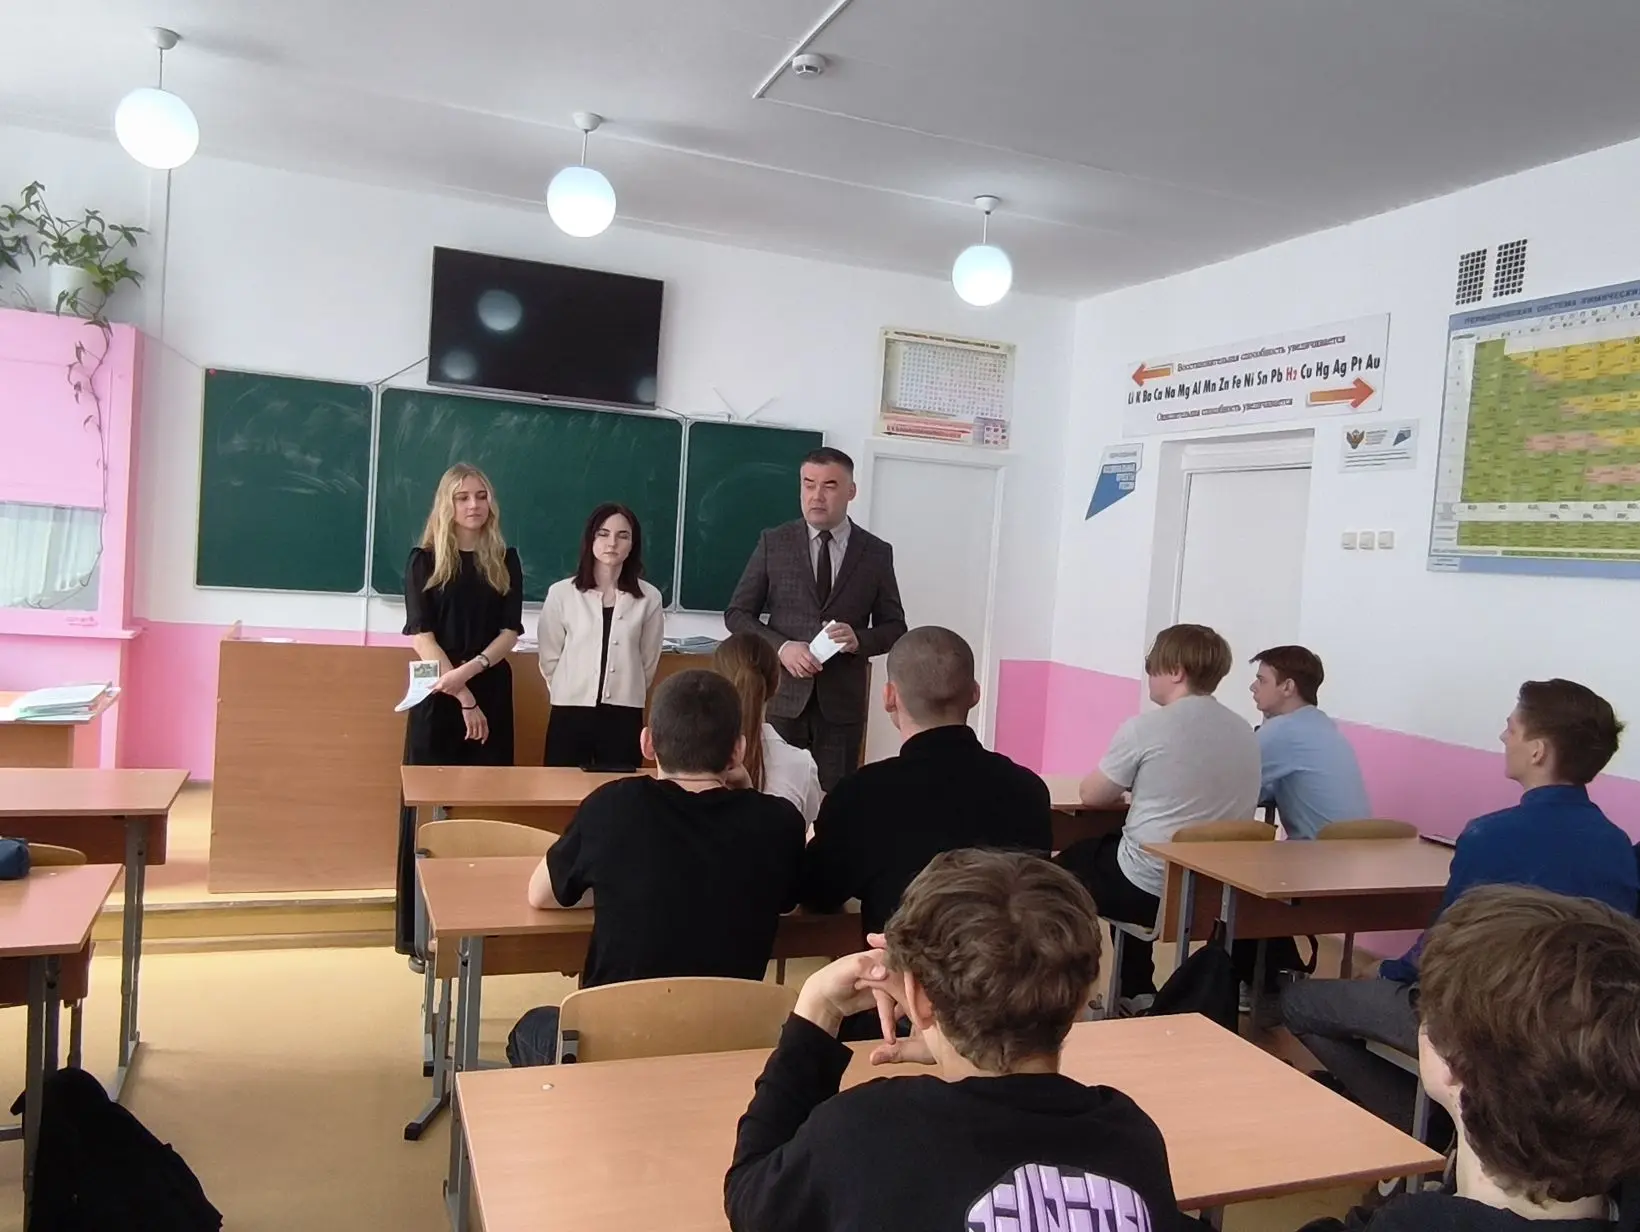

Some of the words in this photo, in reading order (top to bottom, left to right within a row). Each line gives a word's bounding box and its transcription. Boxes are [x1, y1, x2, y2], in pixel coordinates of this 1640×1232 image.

[1128, 391, 1134, 405] Li
[1136, 390, 1142, 403] K
[1142, 390, 1152, 403] Ba
[1153, 388, 1163, 401] Ca
[1164, 386, 1176, 399] Na
[1177, 384, 1190, 400] Mg
[1192, 381, 1201, 395] Al
[1203, 379, 1216, 393] Mn
[1218, 377, 1229, 392] Zn
[1232, 375, 1242, 389] Fe
[1244, 373, 1254, 387] Ni
[1257, 370, 1268, 386] Sn
[1270, 368, 1283, 383] Pb
[1300, 363, 1312, 379] Cu
[1315, 361, 1330, 380] Hg
[1332, 359, 1347, 377] Ag
[1351, 356, 1363, 372] Pt
[1365, 354, 1380, 370] Au
